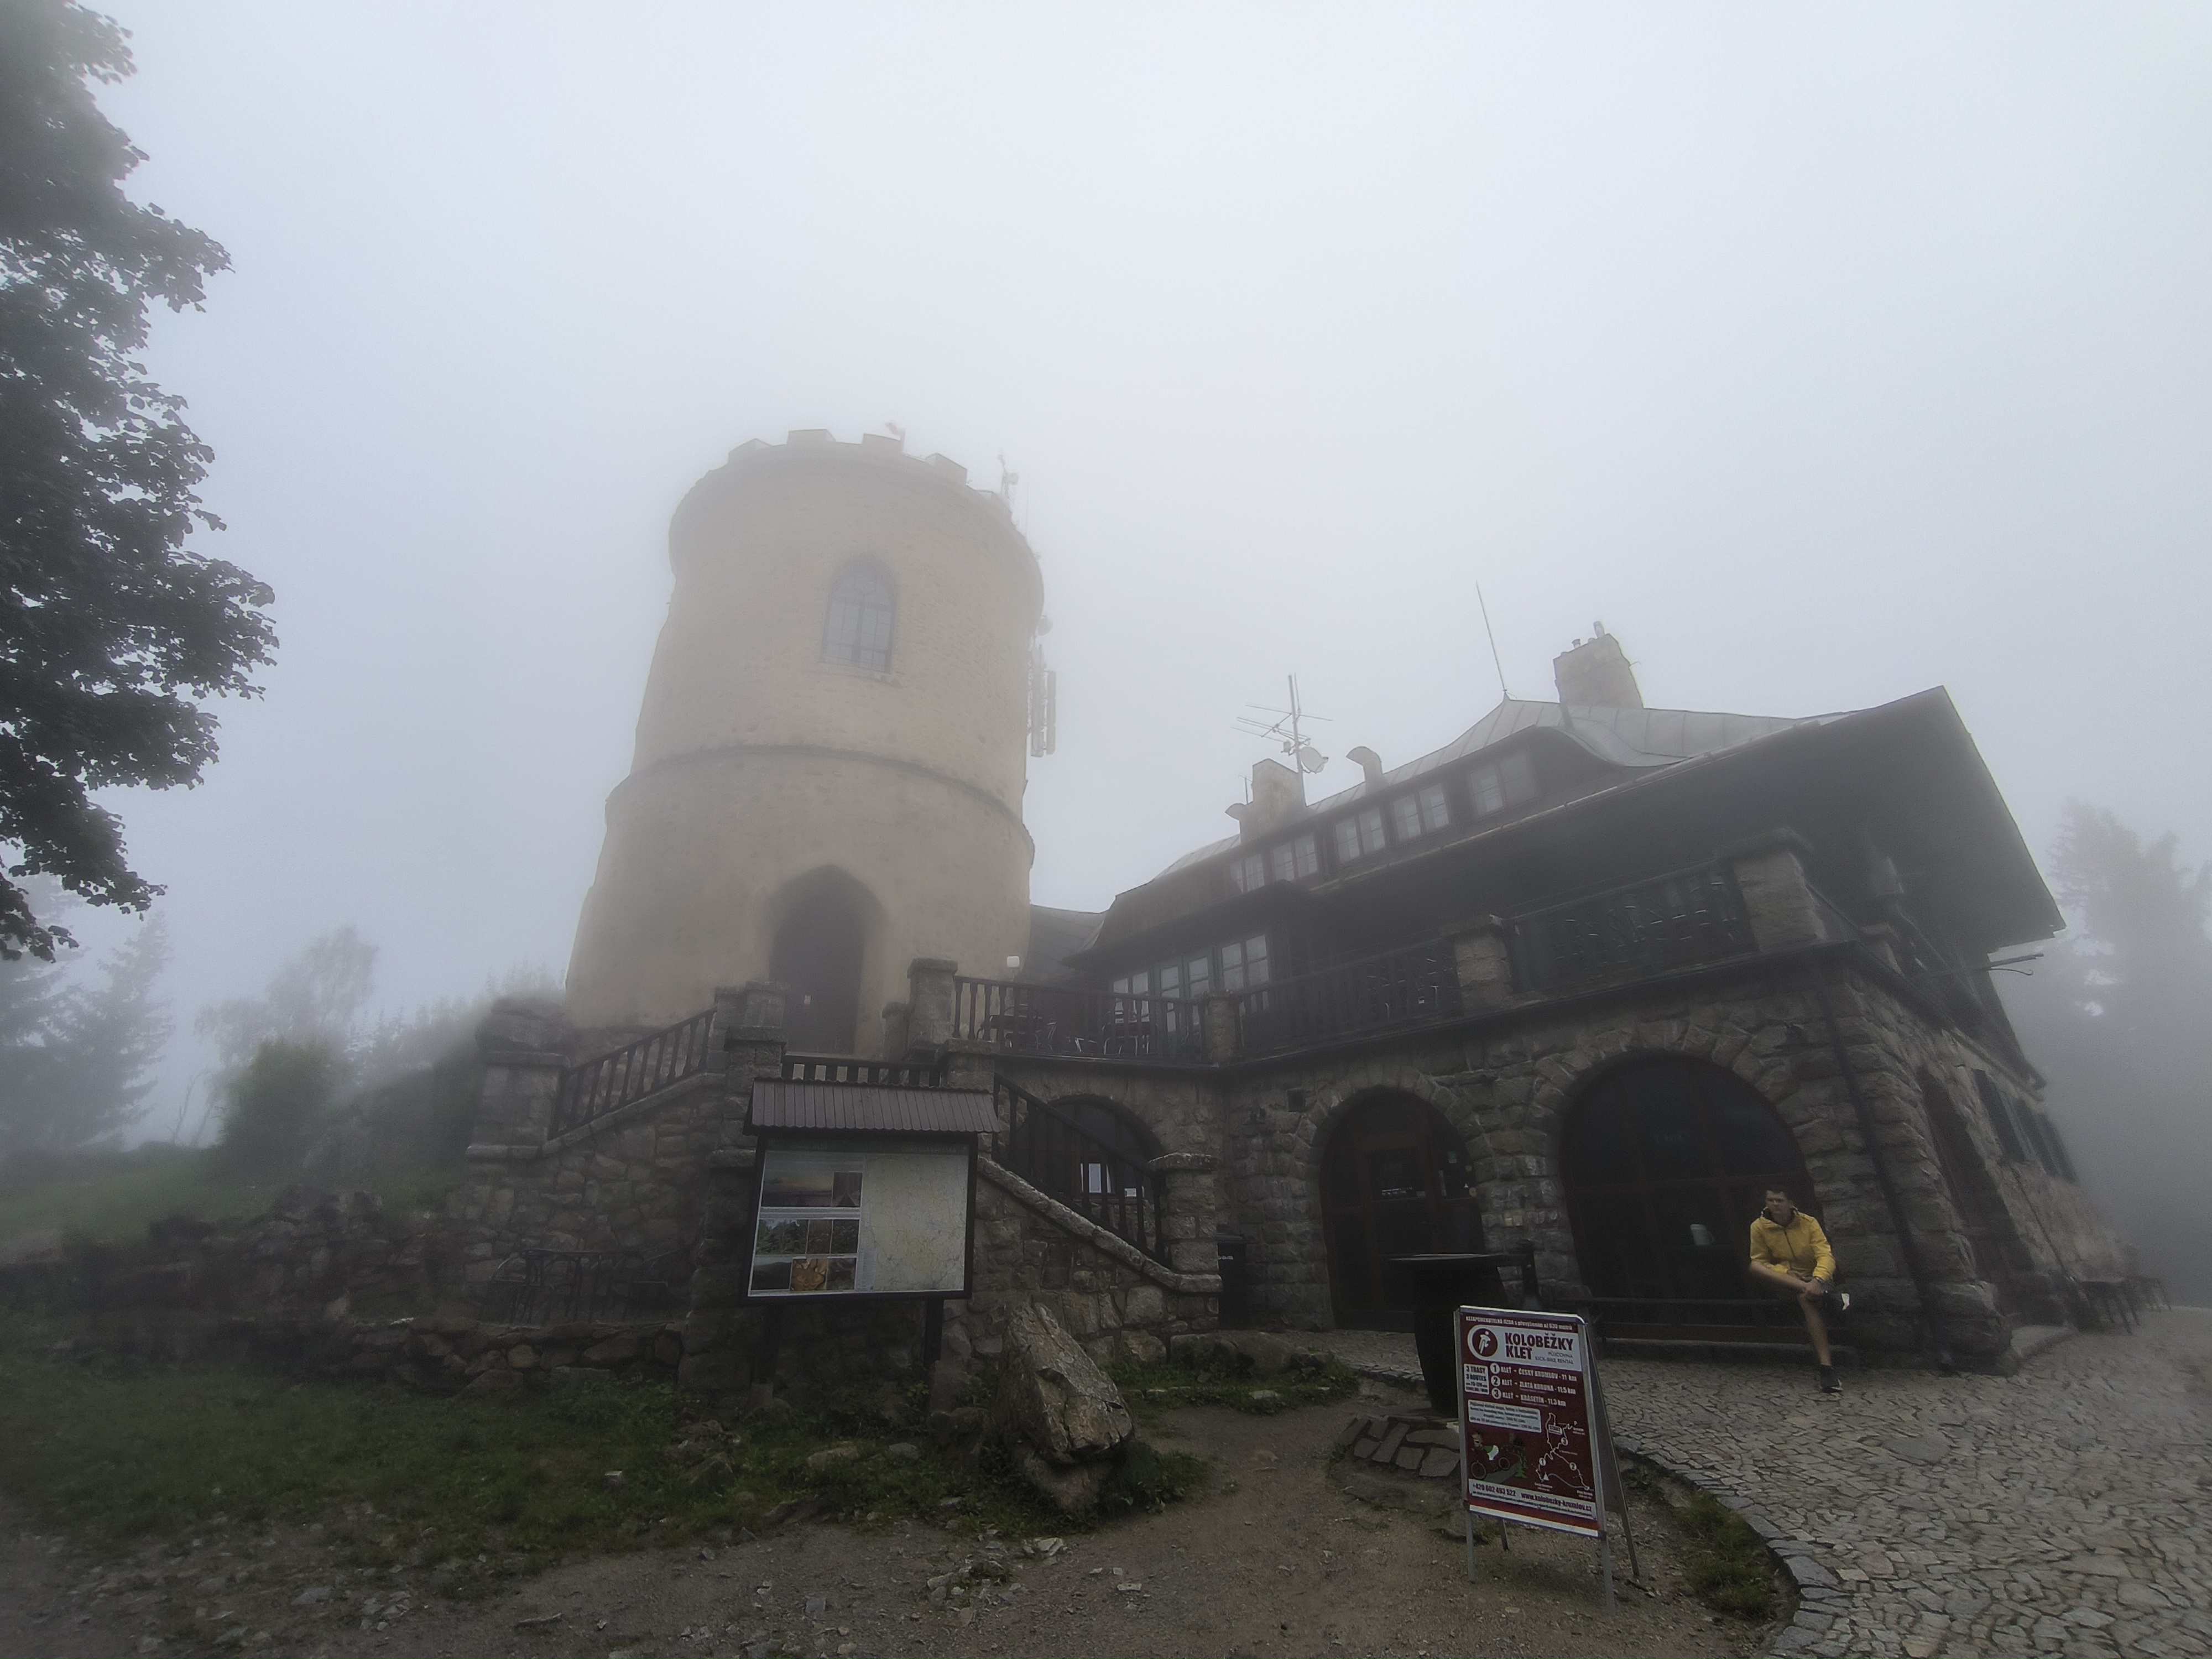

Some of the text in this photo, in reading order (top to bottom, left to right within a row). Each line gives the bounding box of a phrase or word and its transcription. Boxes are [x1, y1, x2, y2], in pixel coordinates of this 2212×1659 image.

[1505, 1333, 1573, 1350] KOLOBĚŽKY
[1506, 1345, 1532, 1360] KLEŤ
[1519, 1368, 1533, 1376] ČESKÝ
[1535, 1370, 1558, 1379] KRUMLOV
[1494, 1376, 1498, 1385] 2
